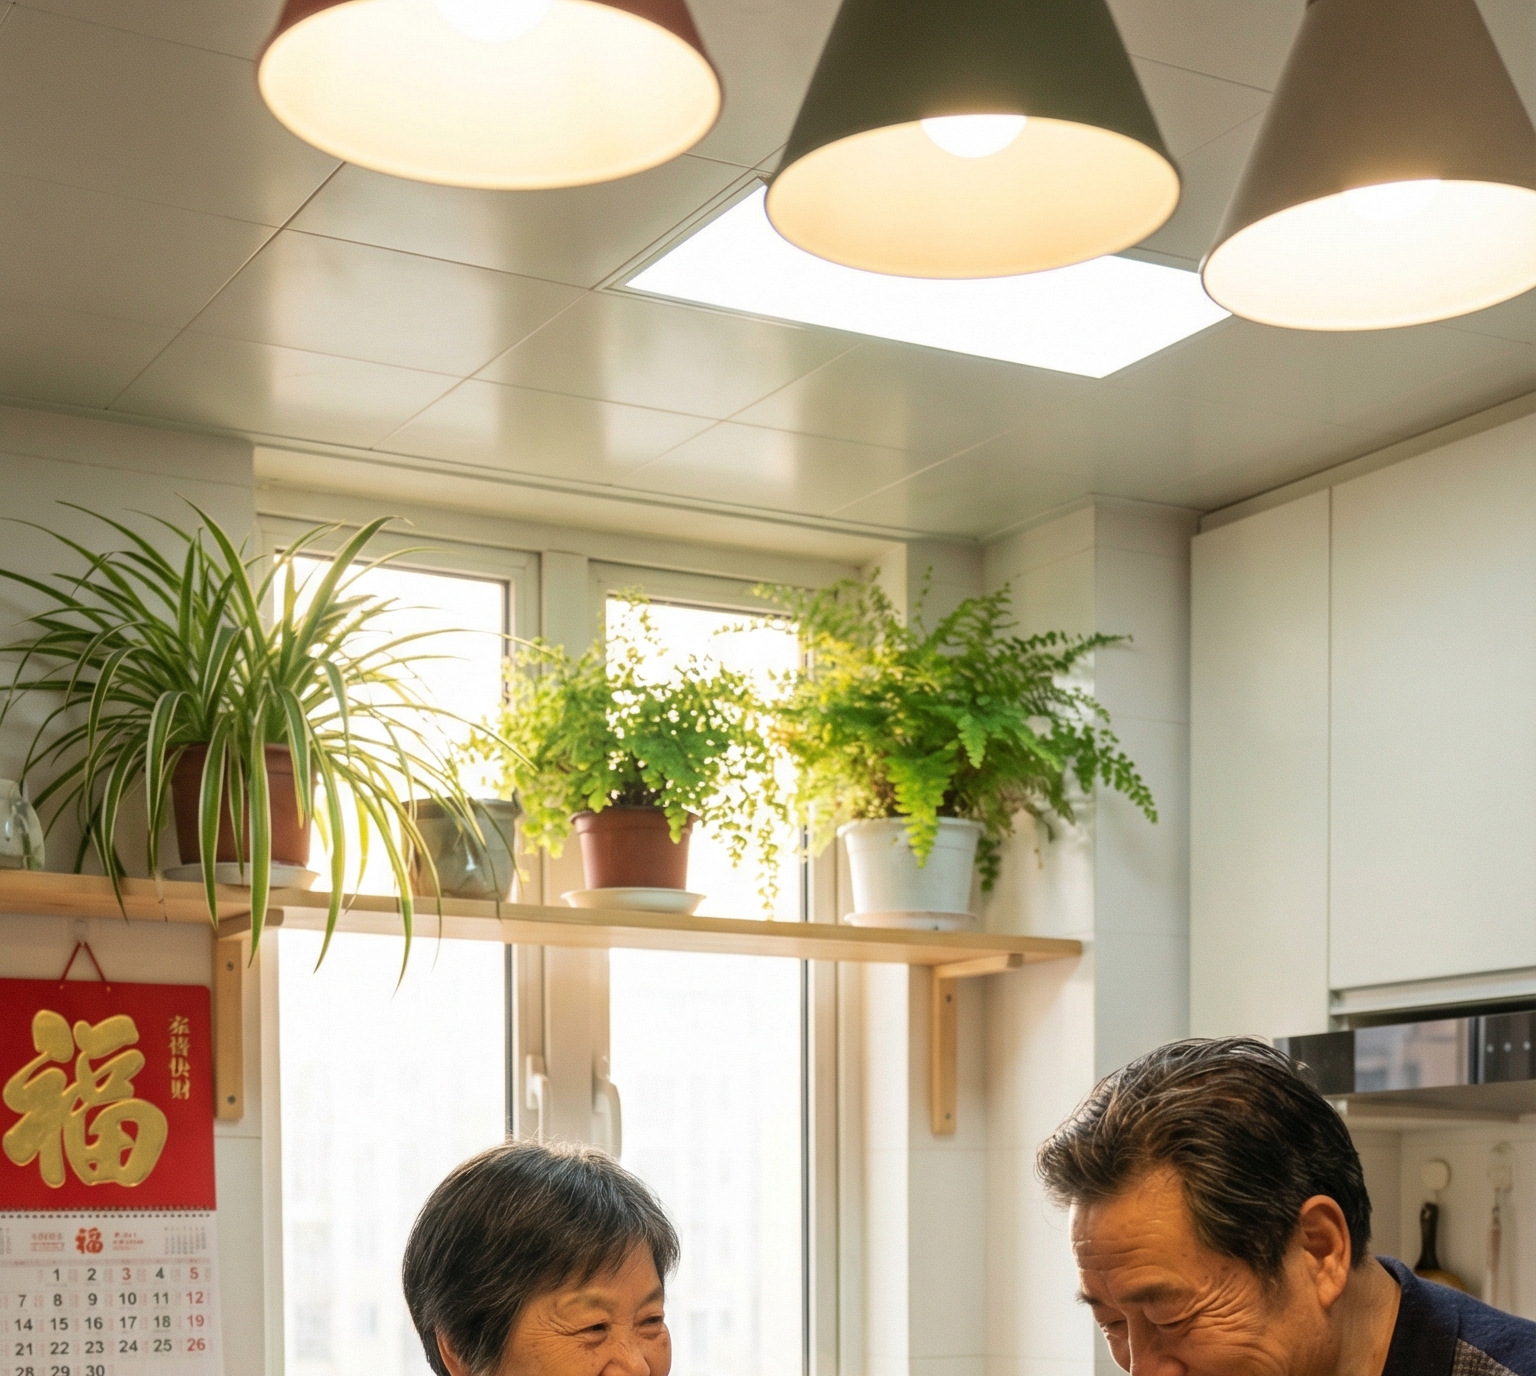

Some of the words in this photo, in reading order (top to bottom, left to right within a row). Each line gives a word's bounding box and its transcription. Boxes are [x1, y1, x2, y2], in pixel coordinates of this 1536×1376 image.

[3, 1009, 168, 1188] 福
[75, 1227, 104, 1255] 福
[52, 1268, 60, 1282] 1
[87, 1267, 97, 1282] 2
[122, 1266, 132, 1281] 3
[155, 1266, 165, 1280] 4
[189, 1266, 199, 1280] 5
[17, 1293, 27, 1308] 7
[53, 1293, 63, 1307] 8
[87, 1292, 98, 1307] 9
[118, 1291, 138, 1306] 10
[153, 1291, 169, 1305] 11
[185, 1290, 204, 1305] 12
[14, 1318, 33, 1332] 14
[50, 1317, 69, 1331] 15
[84, 1316, 104, 1331] 16
[119, 1315, 138, 1329] 17
[153, 1315, 171, 1329] 18
[187, 1314, 205, 1328] 19
[15, 1342, 33, 1357] 21
[50, 1341, 70, 1356] 22
[84, 1340, 105, 1355] 23
[119, 1339, 139, 1354] 24
[153, 1338, 173, 1353] 25
[186, 1337, 206, 1352] 26
